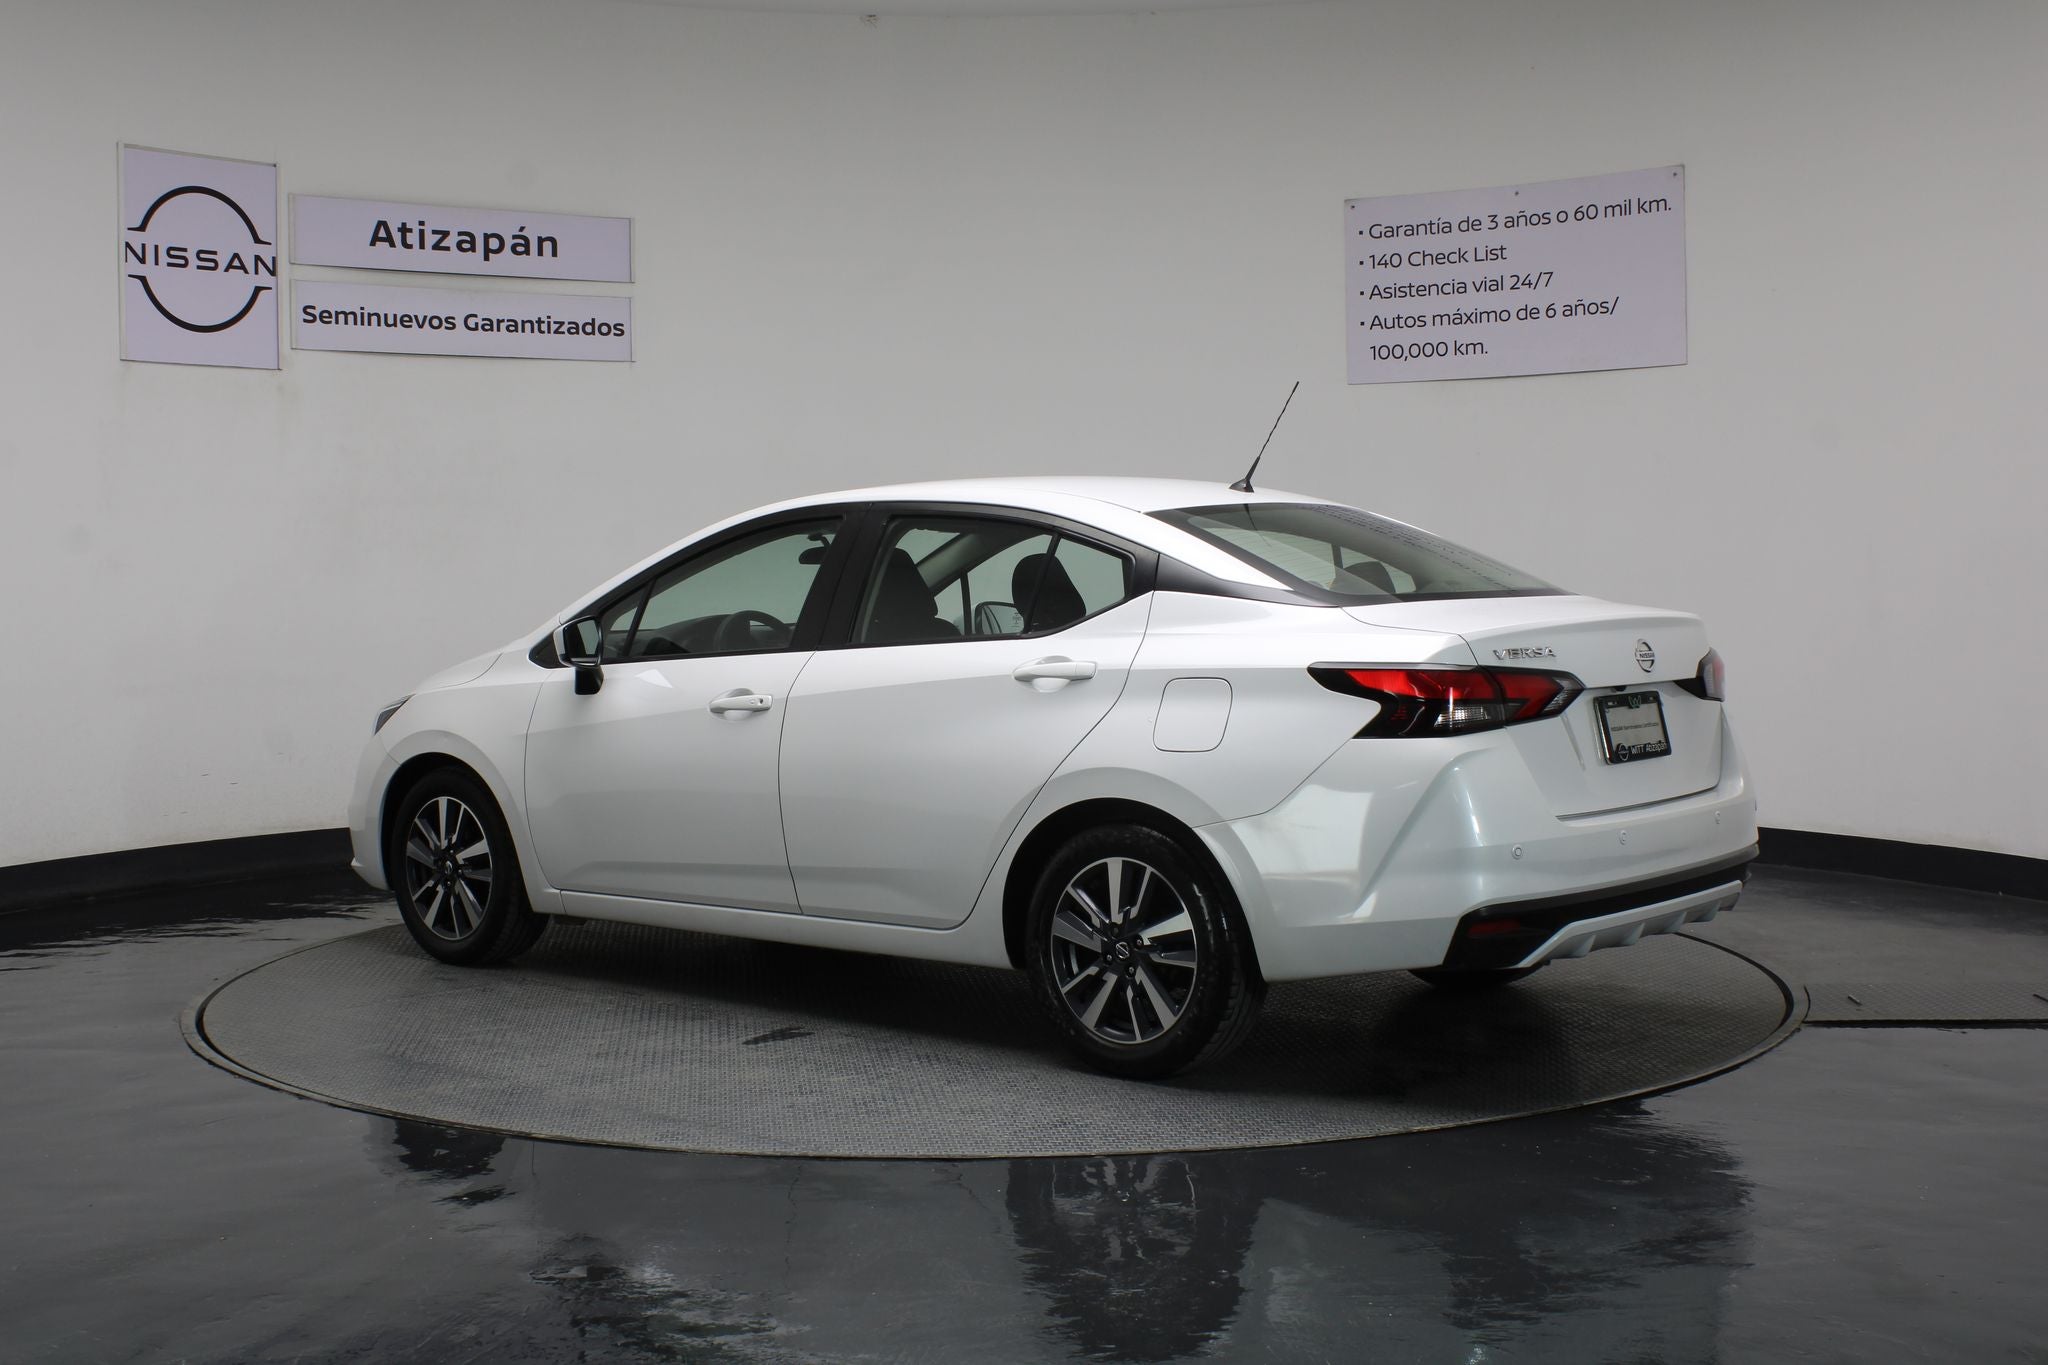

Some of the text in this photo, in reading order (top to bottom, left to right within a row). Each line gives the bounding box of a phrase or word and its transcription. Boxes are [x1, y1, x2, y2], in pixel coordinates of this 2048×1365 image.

[1368, 197, 1673, 240] Garantía de 3 años o 60 mil km.
[369, 220, 559, 263] Atizapán
[1368, 244, 1508, 270] 140 Check List
[124, 240, 277, 278] NISSAN
[1368, 271, 1554, 301] Asistencia vial 24/7
[302, 304, 626, 338] Seminuevos Garantizados
[1369, 296, 1620, 331] Autos máximo de 6 años/
[1369, 340, 1489, 362] 100,000 km.
[1492, 646, 1557, 661] VERSA
